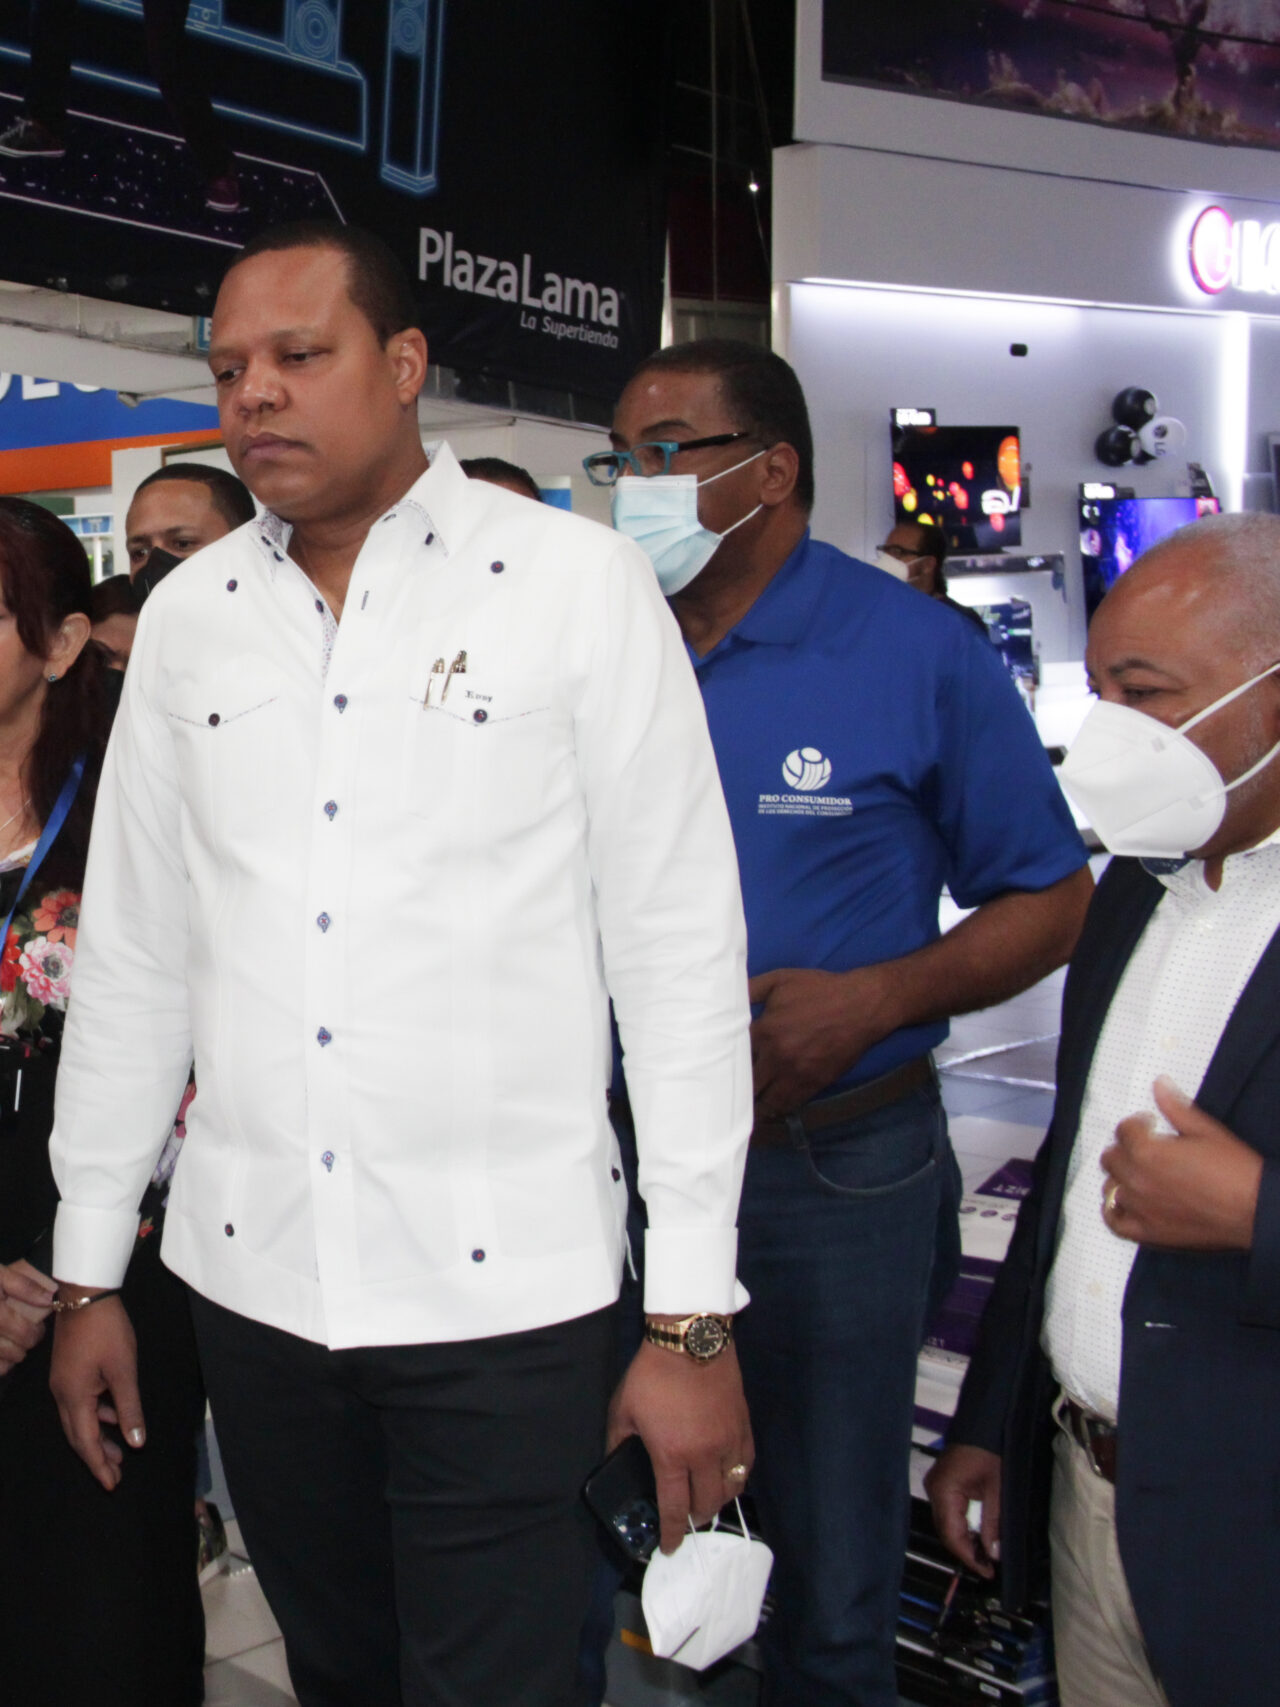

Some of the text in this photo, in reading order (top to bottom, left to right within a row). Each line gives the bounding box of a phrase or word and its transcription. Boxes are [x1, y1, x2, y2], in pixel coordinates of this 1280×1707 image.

[418, 227, 620, 328] PlazaLama
[520, 311, 619, 349] La Supertienda
[759, 794, 852, 806] PRO CONSUMIDOR
